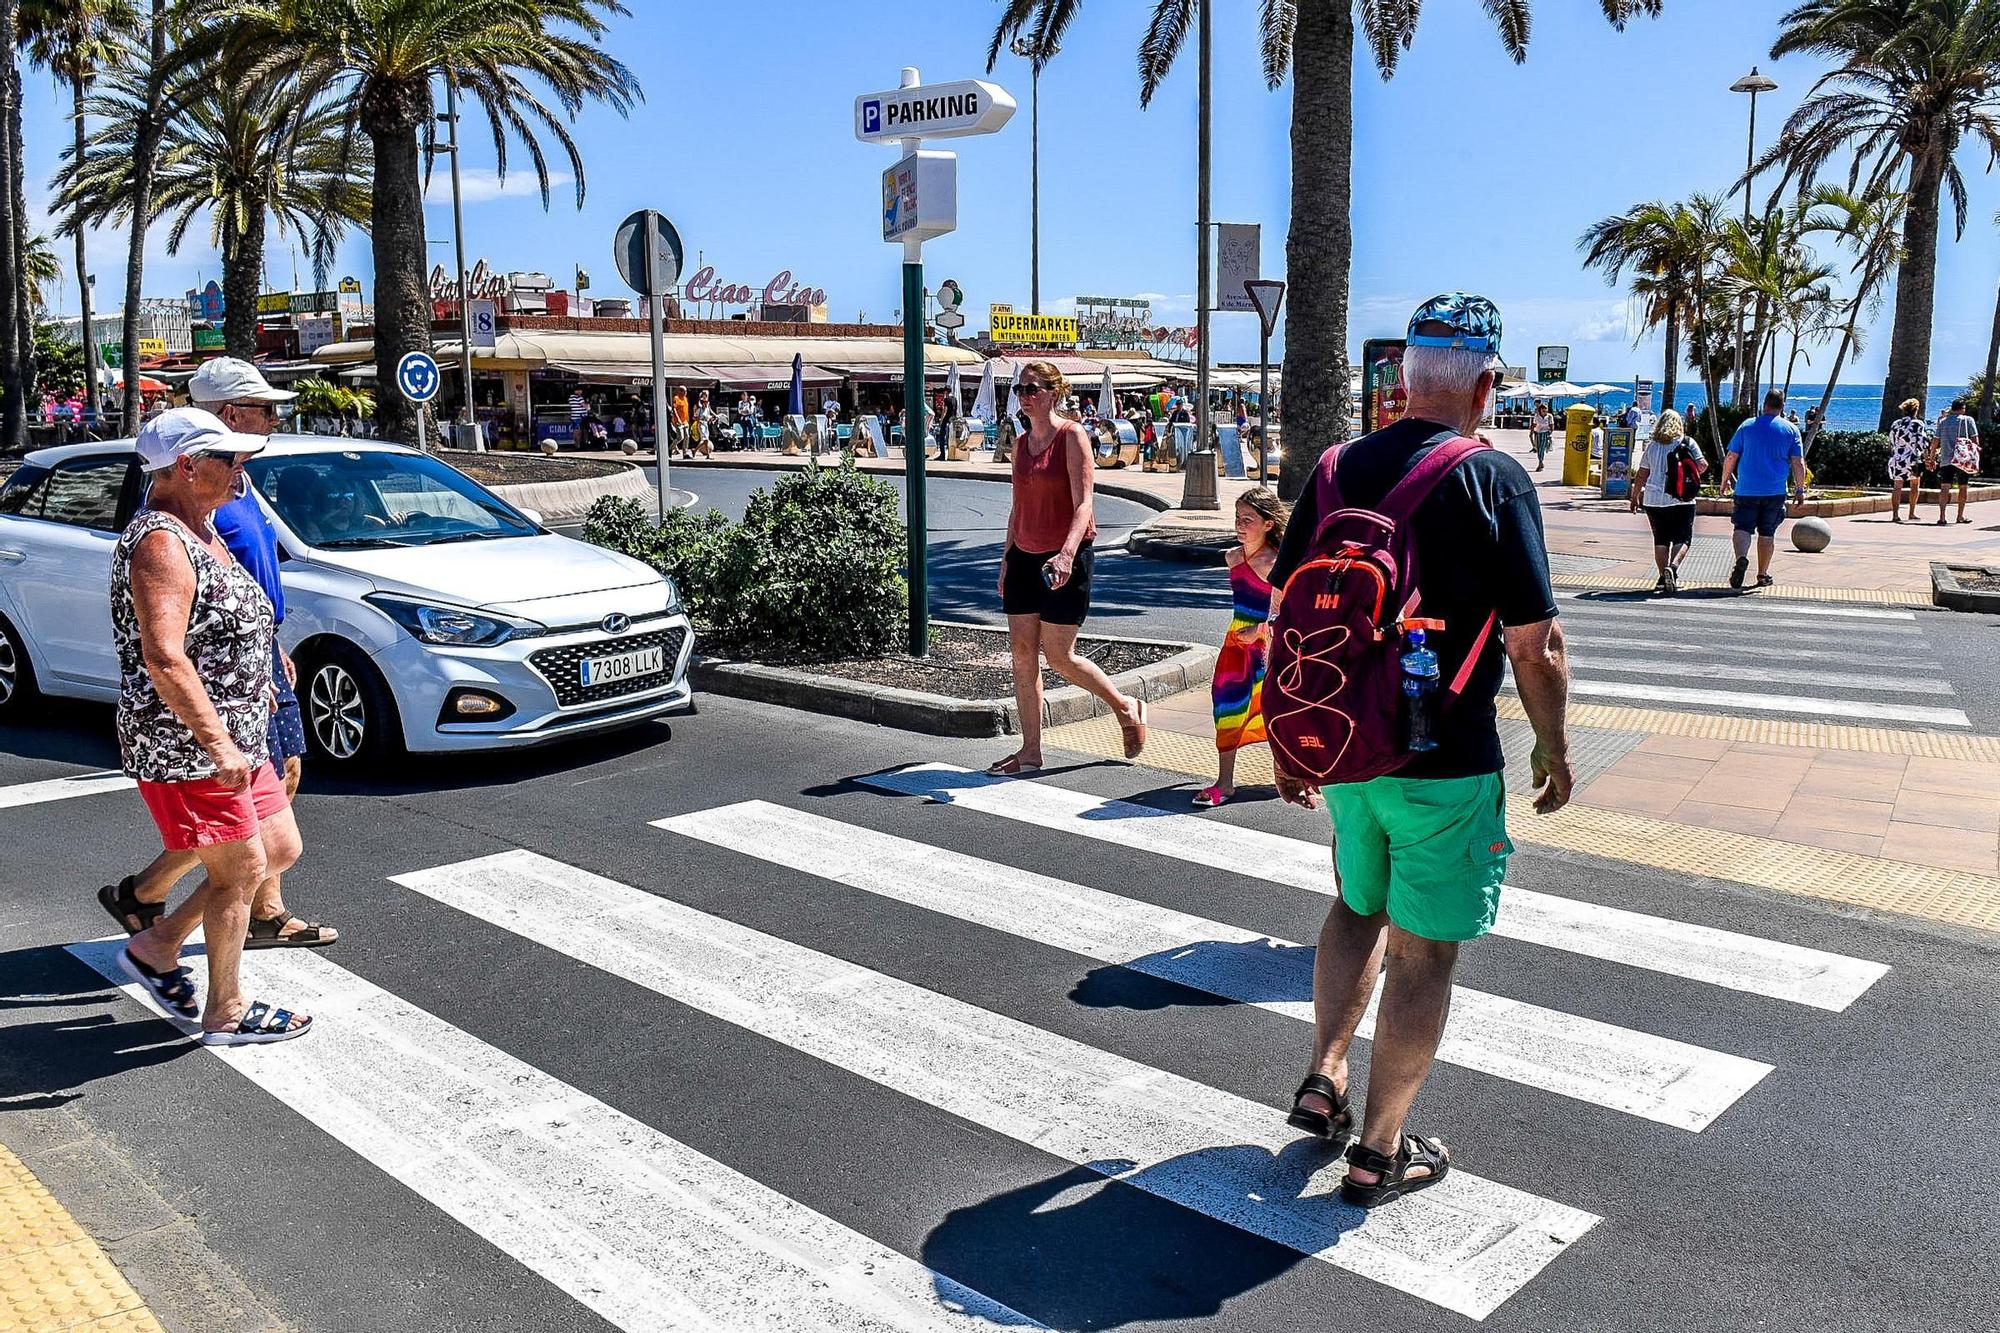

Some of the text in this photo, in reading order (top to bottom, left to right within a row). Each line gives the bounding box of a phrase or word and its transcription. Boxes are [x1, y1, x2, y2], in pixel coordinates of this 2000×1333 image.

[887, 93, 978, 125] PARKING
[429, 264, 459, 299] Cia
[685, 266, 828, 306] Ciao Ciao
[295, 296, 315, 311] MEDI
[478, 312, 492, 332] 8
[993, 316, 1076, 332] SUPERMARKET
[998, 332, 1070, 343] INTERNATIONAL PRESS
[632, 377, 650, 386] CIAO
[767, 381, 783, 390] CIAO
[549, 424, 567, 433] CIAO
[1315, 593, 1340, 609] HH
[593, 650, 660, 681] 7308 LLK
